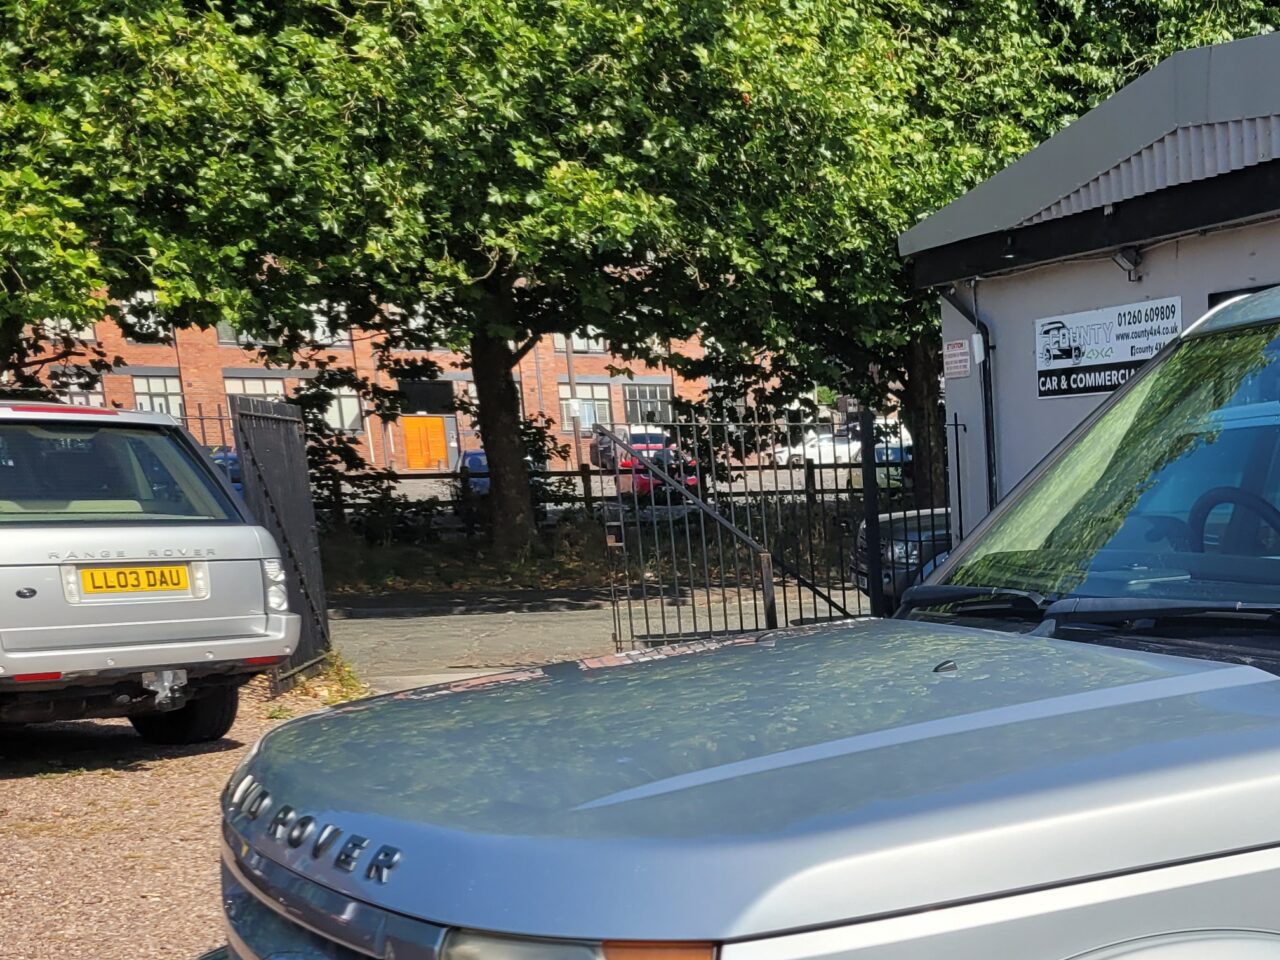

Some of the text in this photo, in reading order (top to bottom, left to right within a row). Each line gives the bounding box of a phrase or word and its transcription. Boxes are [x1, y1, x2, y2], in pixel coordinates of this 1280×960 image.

[1117, 304, 1176, 327] 01260 609809
[1049, 321, 1113, 350] COUNTY
[1115, 322, 1179, 341] www.county4x4.co.uk
[1040, 376, 1059, 391] CAR
[1060, 375, 1068, 389] &
[48, 548, 217, 560] RANGE ROVER
[90, 569, 181, 590] LL03 DAU
[267, 804, 403, 885] ROVER
